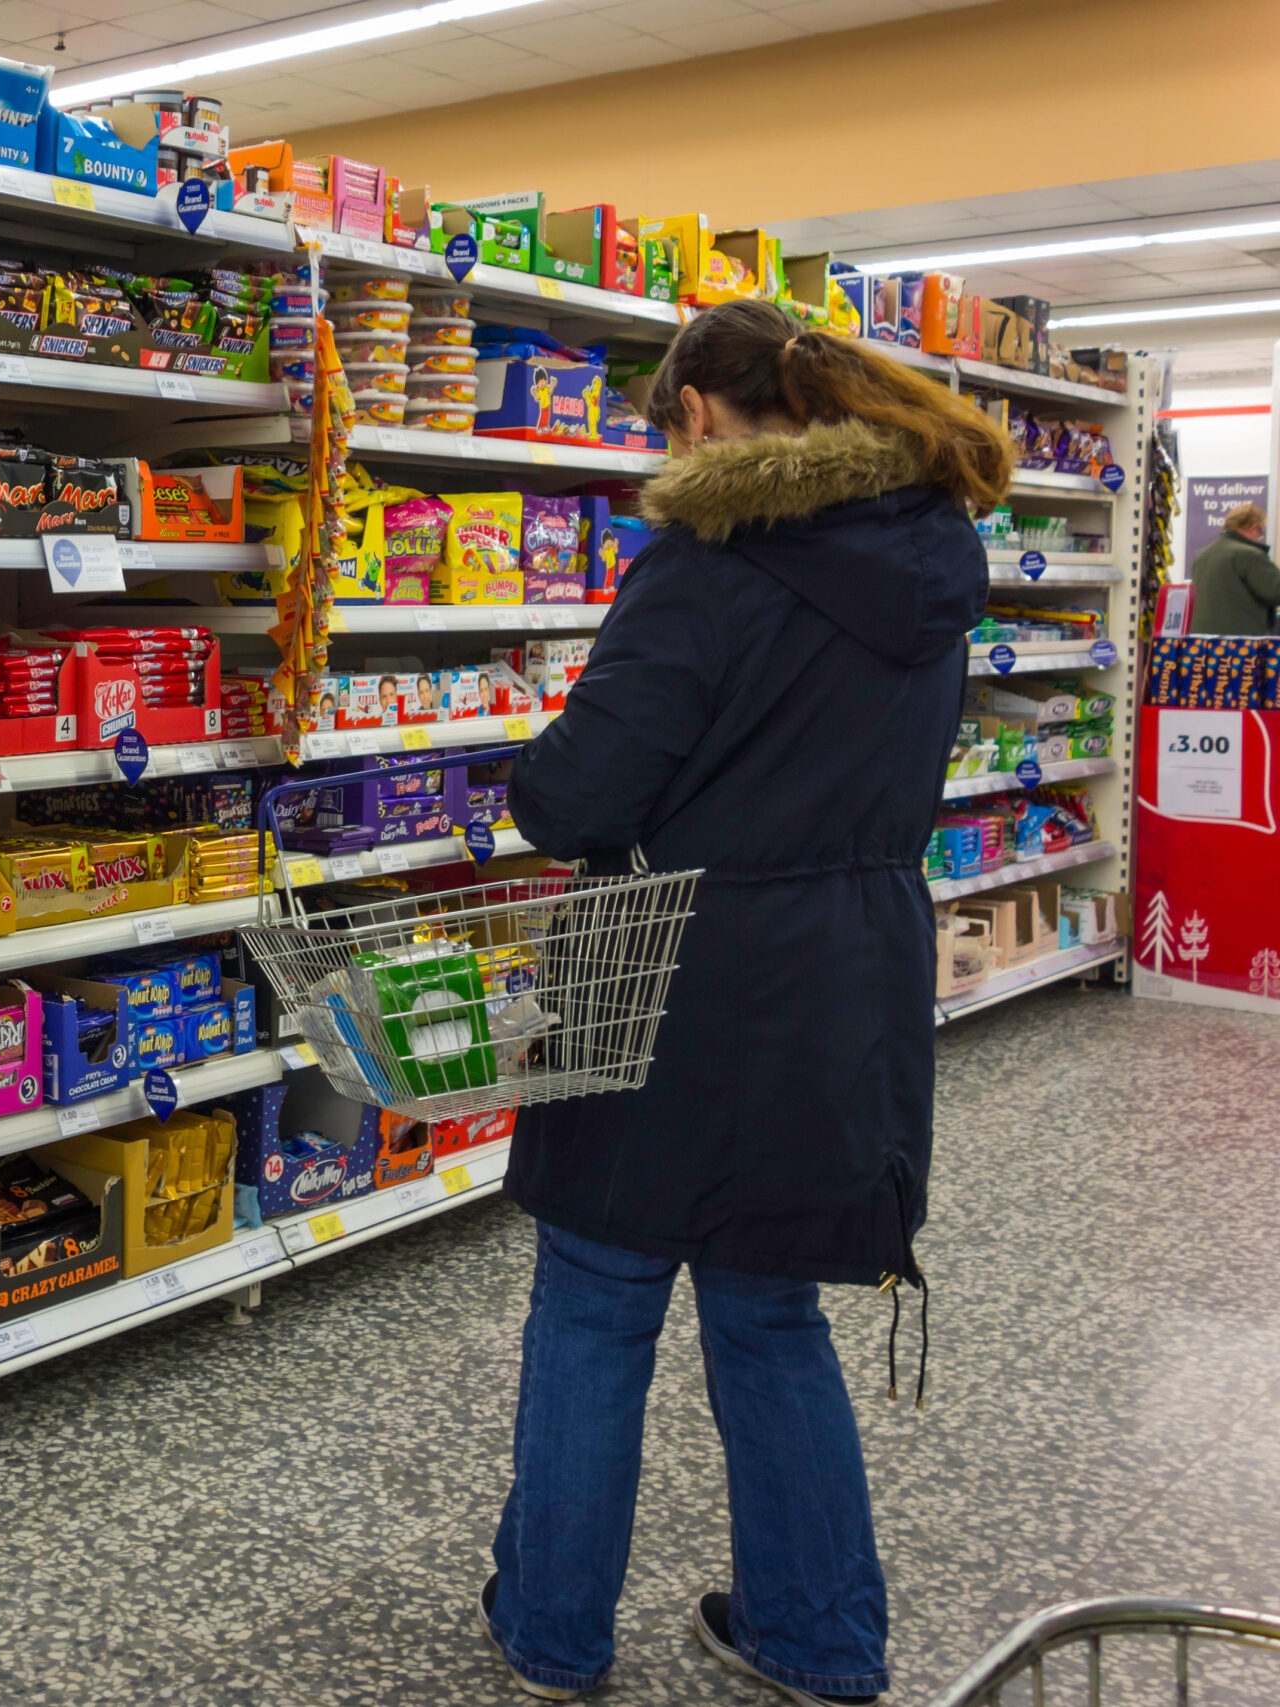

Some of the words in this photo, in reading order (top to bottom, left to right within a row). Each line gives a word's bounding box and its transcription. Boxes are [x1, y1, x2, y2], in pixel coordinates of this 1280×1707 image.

[84, 157, 135, 183] BOUNTY
[178, 203, 208, 213] Guarantee
[184, 195, 202, 204] Brand
[447, 256, 475, 265] Guarantee
[452, 249, 470, 258] Brand
[148, 352, 170, 367] NEW
[184, 354, 226, 373] SNICKERS
[553, 396, 585, 417] HARIBO
[1193, 484, 1215, 496] We
[1219, 483, 1265, 497] deliver
[1204, 499, 1218, 510] to
[37, 511, 74, 532] Mars
[74, 516, 86, 525] Bars
[484, 580, 519, 597] BUMPER
[97, 681, 135, 718] KitKat
[62, 717, 70, 735] 4
[209, 711, 217, 727] 8
[121, 746, 140, 755] Brand
[1169, 735, 1230, 754] £3.00
[116, 754, 147, 763] Guarantee
[69, 1079, 98, 1097] CHOCOLATE
[99, 1074, 118, 1088] CREAM
[151, 1085, 169, 1095] Brand
[267, 1159, 283, 1178] 14
[380, 1159, 415, 1182] Fudge
[11, 1277, 57, 1304] CRAZY
[58, 1256, 119, 1289] CARAMEL
